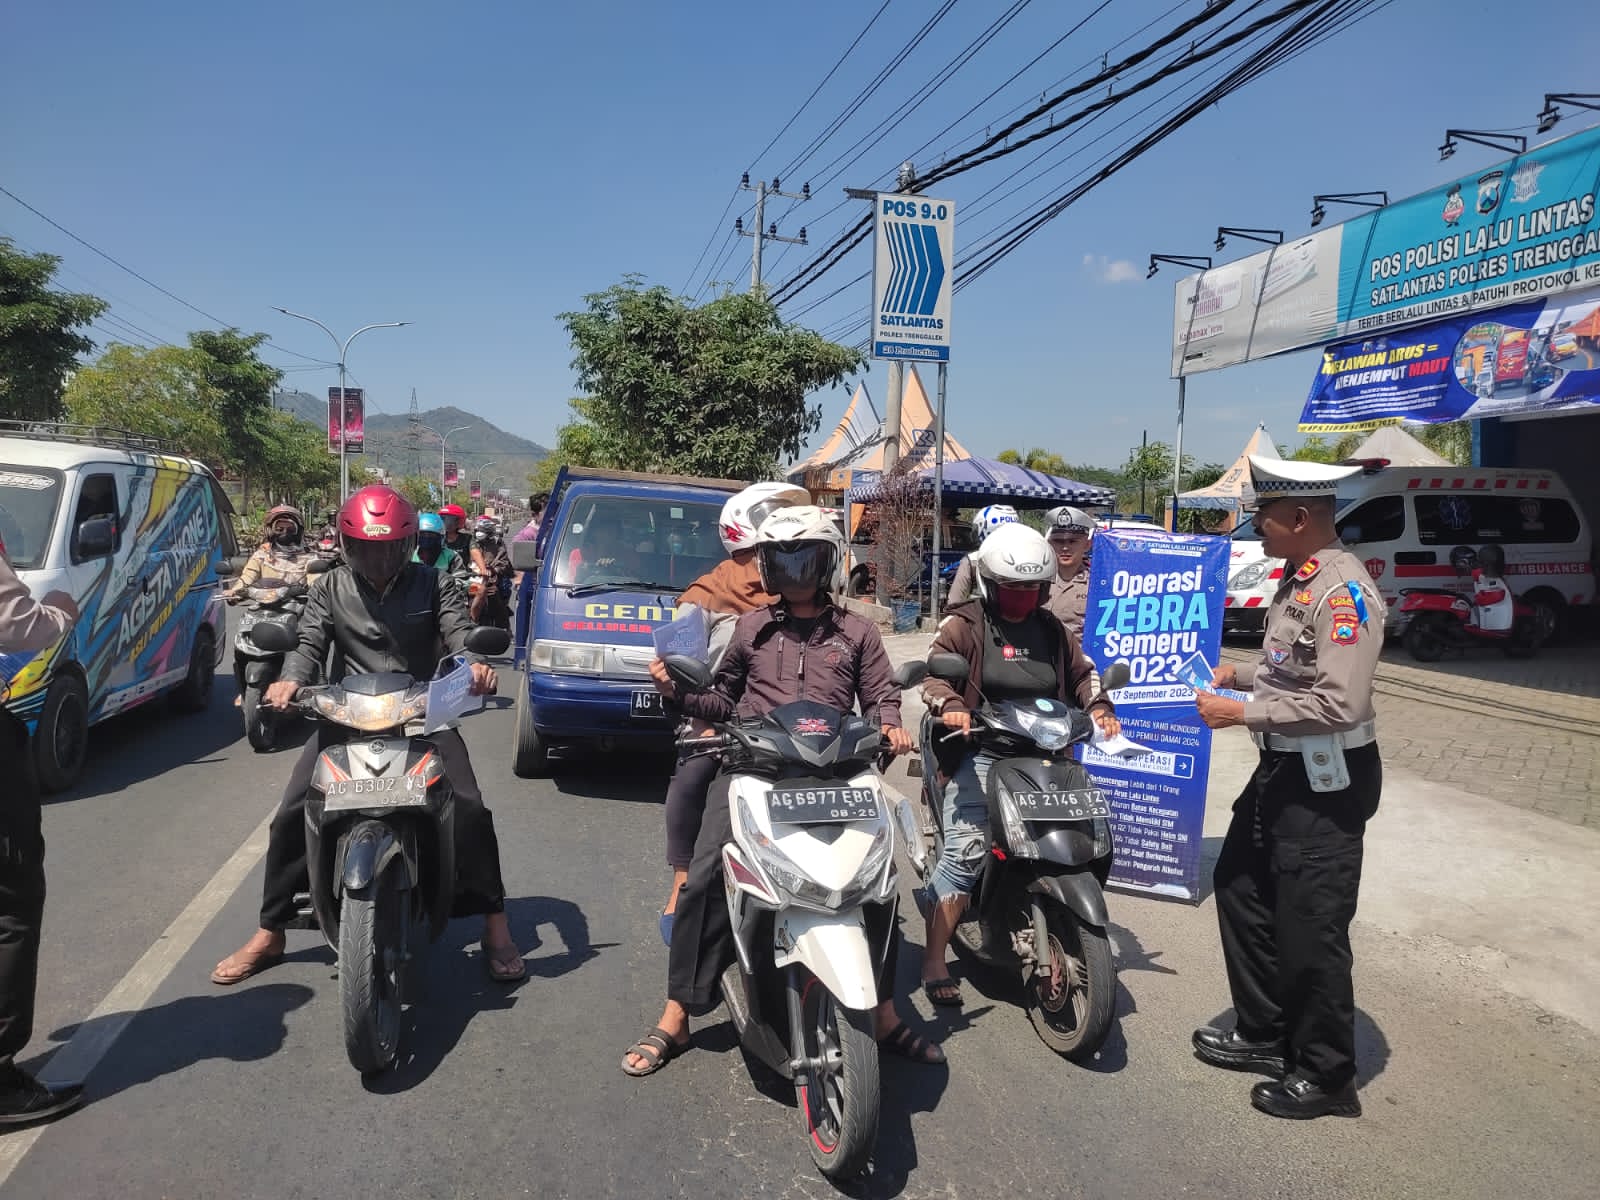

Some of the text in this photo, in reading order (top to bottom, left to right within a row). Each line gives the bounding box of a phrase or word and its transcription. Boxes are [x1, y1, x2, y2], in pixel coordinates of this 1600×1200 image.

[883, 200, 947, 220] POS 9.0
[1371, 193, 1595, 283] POS POLISI LALU LINTAS
[1370, 230, 1600, 308] SATLANTAS POLRES TRENGGA
[1358, 314, 1384, 329] TERTIB
[1385, 305, 1425, 323] BERLALU
[1426, 298, 1459, 315] LINTAS
[1472, 285, 1510, 304] PATUHI
[1513, 270, 1581, 296] PROTOKOL
[881, 315, 944, 330] SATLANTAS
[1388, 344, 1426, 364] ARUS
[1408, 357, 1450, 377] MAUT
[1113, 565, 1202, 598] Operasi
[1095, 592, 1209, 636] ZEBRA
[1103, 630, 1198, 658] Semeru
[1113, 654, 1183, 684] 023
[1112, 687, 1194, 701] 17 September 2023
[1136, 731, 1160, 742] PEMILU
[1161, 734, 1181, 745] DAMAI
[1182, 738, 1200, 746] 2024
[328, 782, 346, 795] AG
[355, 778, 394, 793] 6302
[772, 791, 793, 806] AG
[795, 790, 836, 805] 6977
[1019, 793, 1036, 806] AG
[1084, 790, 1104, 804] YZ
